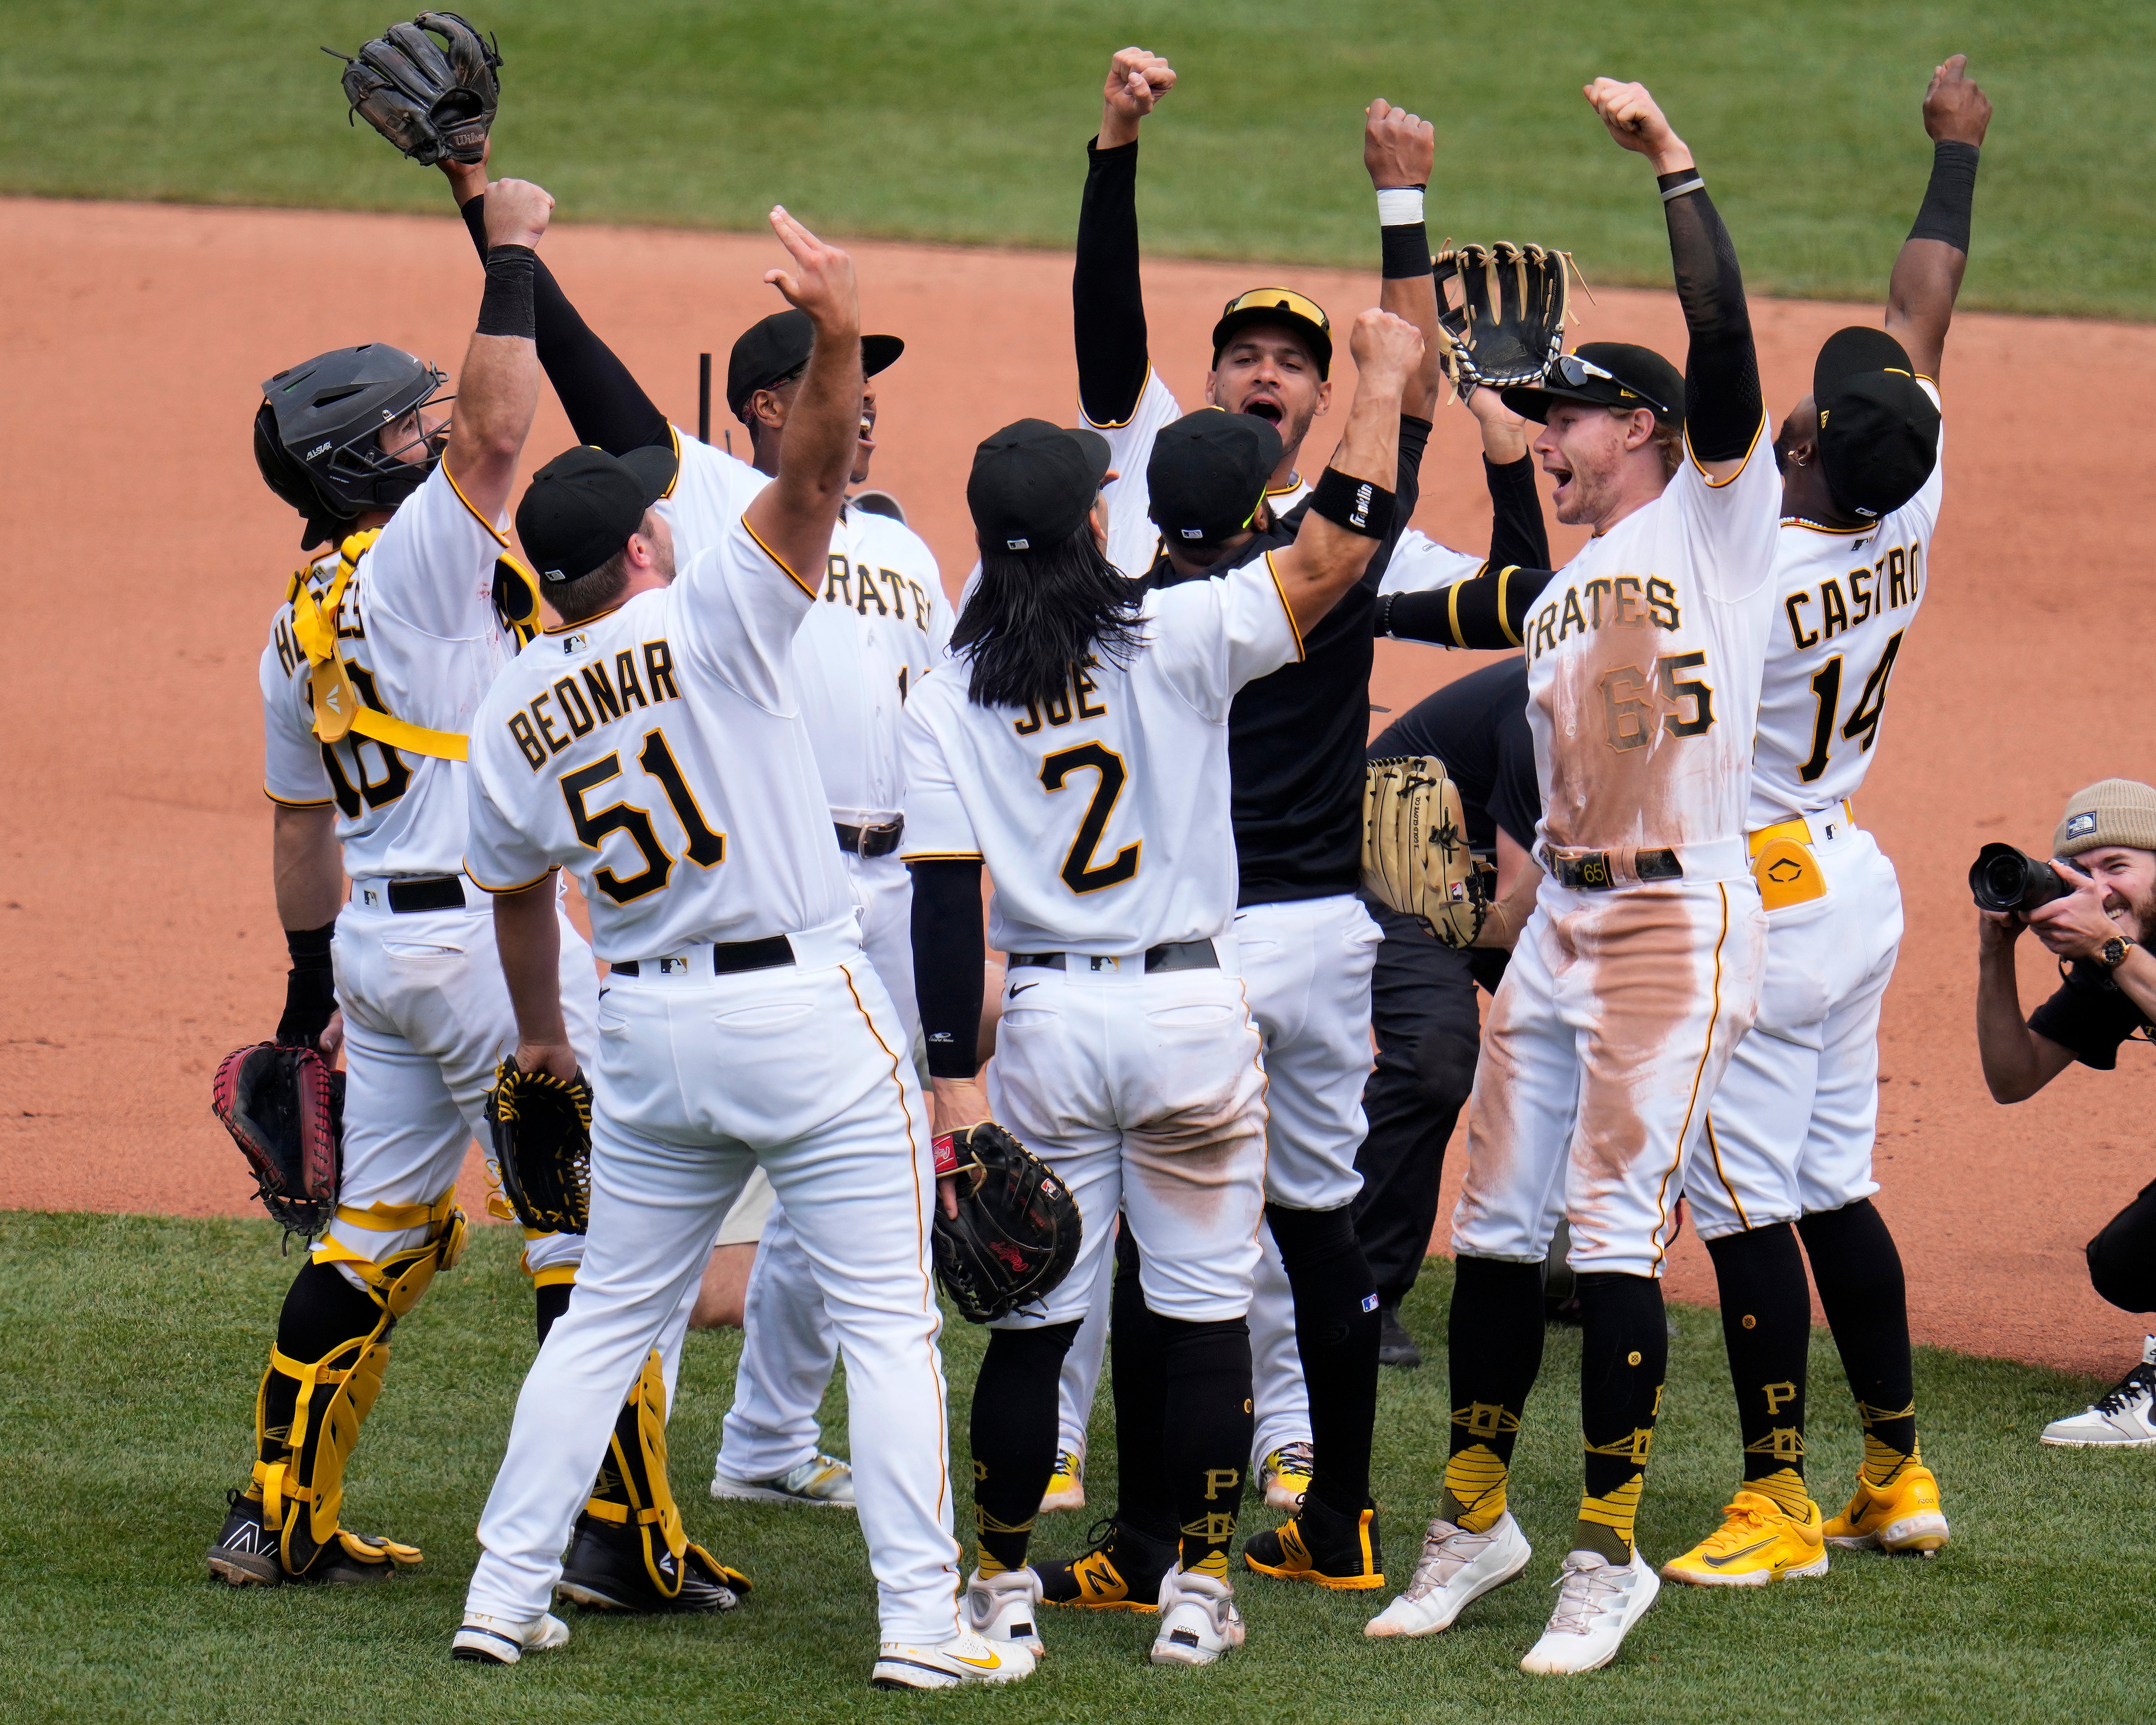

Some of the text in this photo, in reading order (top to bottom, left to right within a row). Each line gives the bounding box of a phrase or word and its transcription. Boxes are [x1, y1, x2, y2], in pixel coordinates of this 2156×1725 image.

[453, 132, 484, 146] Wilson
[1349, 483, 1373, 528] Franklin
[824, 552, 932, 634] RATE
[1784, 541, 1918, 651] CASTRO
[507, 638, 681, 774] BEDNAR
[1597, 649, 1718, 753] 65
[1797, 626, 1905, 784] 14
[558, 727, 727, 906] 51
[1037, 739, 1142, 896] 2
[1584, 863, 1604, 883] 65
[1762, 1380, 1797, 1415] P
[1204, 1468, 1240, 1500] P
